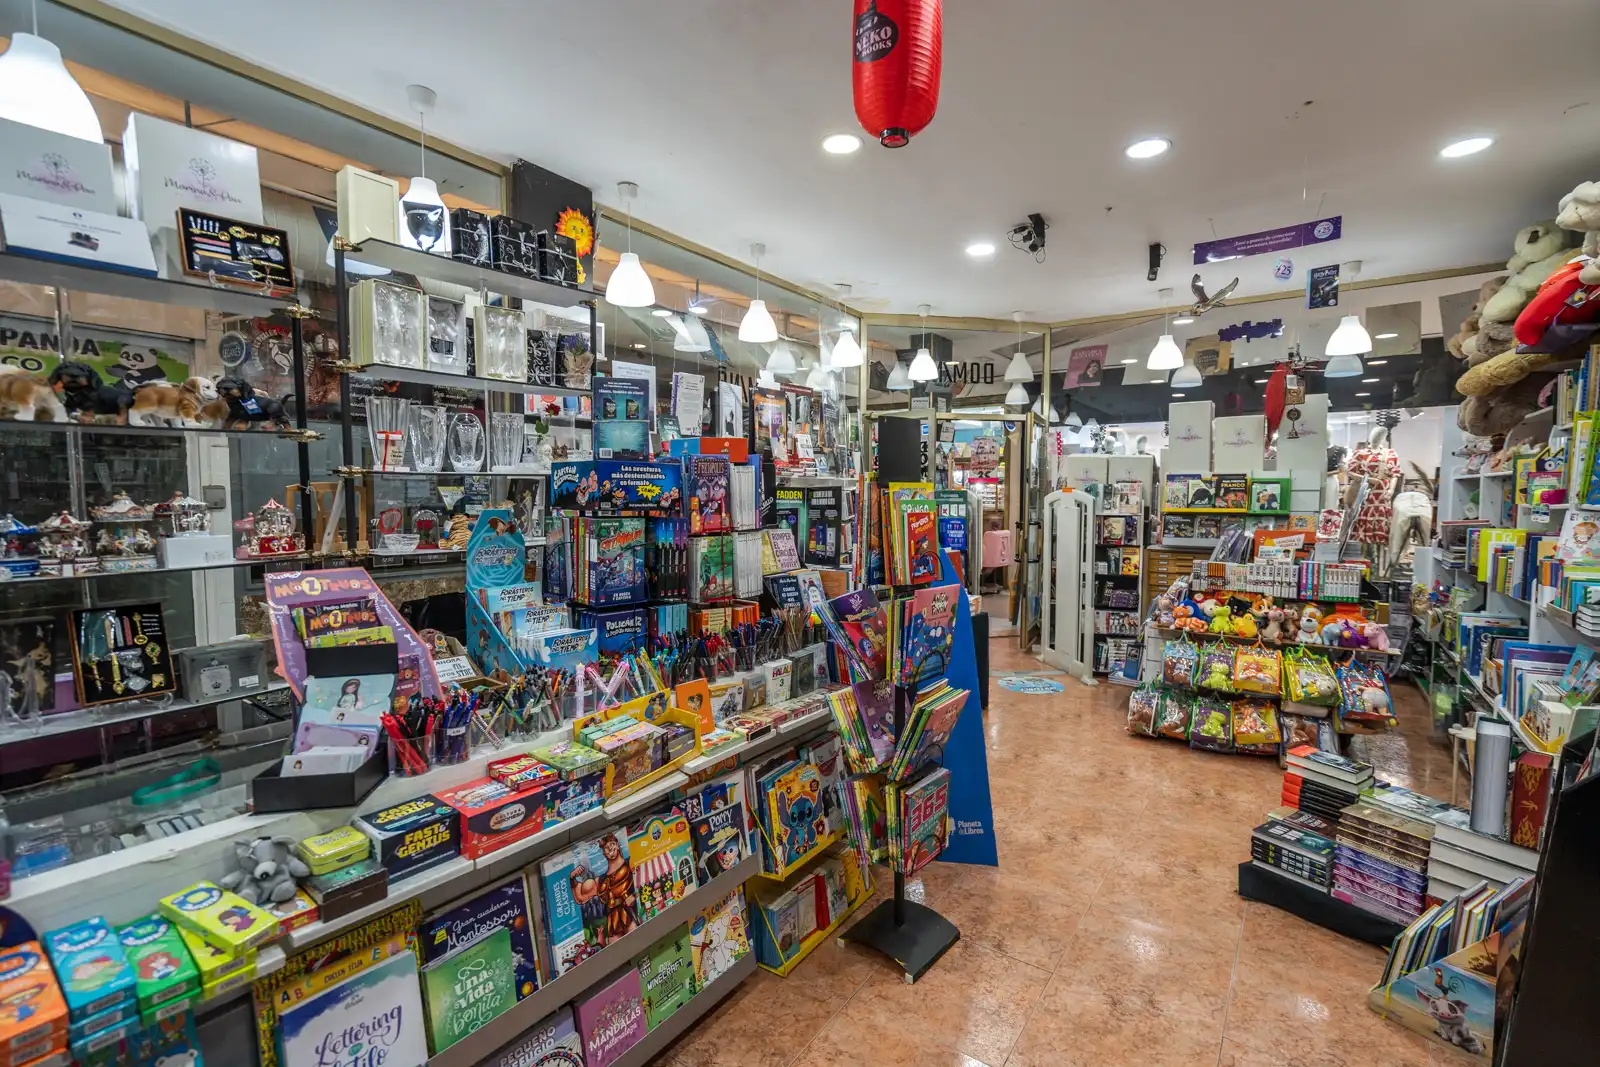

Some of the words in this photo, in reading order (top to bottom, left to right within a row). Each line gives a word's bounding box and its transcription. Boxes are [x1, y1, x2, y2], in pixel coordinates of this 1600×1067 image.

[856, 26, 892, 55] NEKO
[862, 40, 892, 57] BOOKS
[1281, 266, 1292, 276] 25
[776, 490, 803, 500] FADDEN
[771, 532, 792, 541] ROMPER
[773, 541, 780, 549] EL
[274, 577, 375, 598] MOZTRUOS
[310, 610, 377, 631] MOZTRUOS
[605, 618, 634, 630] POLICÁN
[434, 657, 462, 666] AHORA
[779, 678, 785, 687] 3
[494, 808, 522, 820] CULTURA
[911, 781, 948, 834] 365
[708, 809, 733, 832] POPPY
[397, 830, 451, 859] GENIUS
[404, 825, 440, 846] FAST
[1389, 856, 1415, 869] CODICIA
[552, 882, 563, 918] GRANDES
[452, 916, 477, 933] Gran
[476, 899, 511, 919] cuaderno
[446, 904, 521, 952] Montessori
[454, 958, 494, 996] Una
[646, 957, 684, 992] MINECRAFT
[453, 994, 503, 1036] bonita
[315, 1004, 403, 1067] Lettering
[588, 1006, 642, 1052] MANDALAS
[500, 1024, 556, 1065] PEQUEÑO
